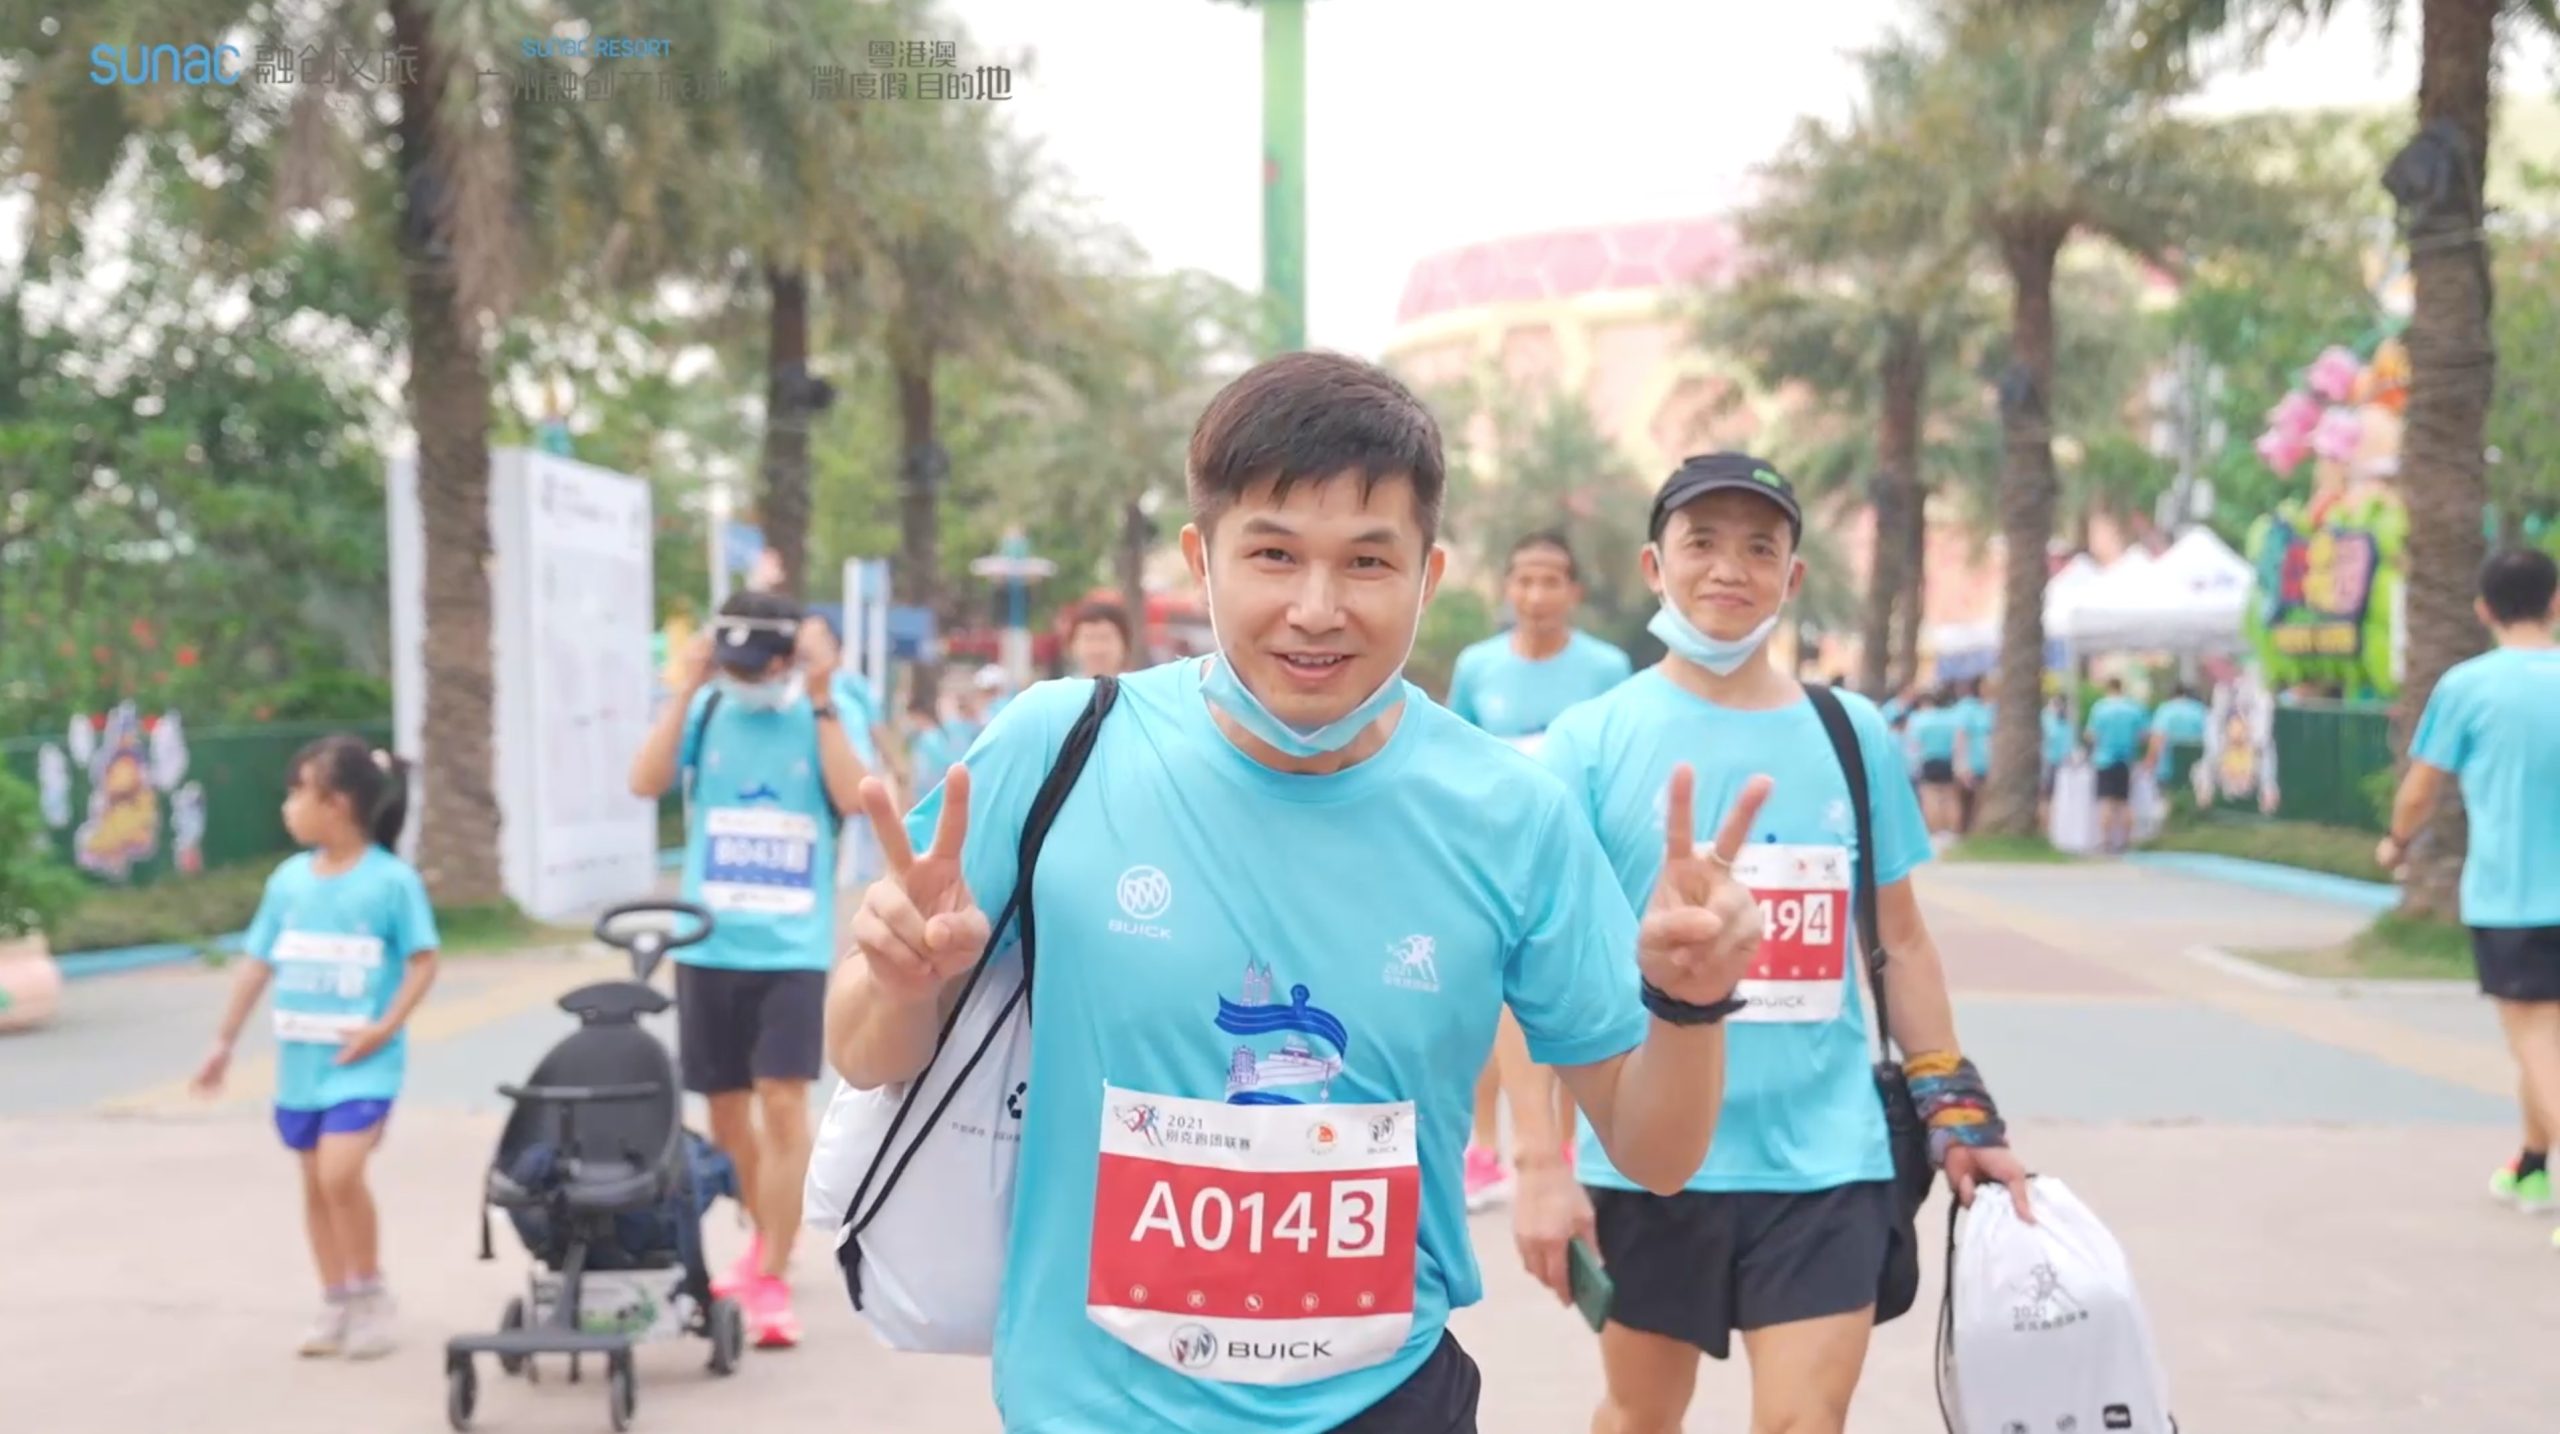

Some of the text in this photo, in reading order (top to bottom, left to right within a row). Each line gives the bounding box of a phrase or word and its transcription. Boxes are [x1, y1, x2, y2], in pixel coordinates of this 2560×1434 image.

[1107, 919, 1173, 941] BUICK
[1167, 1113, 1204, 1130] 2021
[1129, 1180, 1378, 1255] A0143
[1227, 1339, 1334, 1360] BUICK
